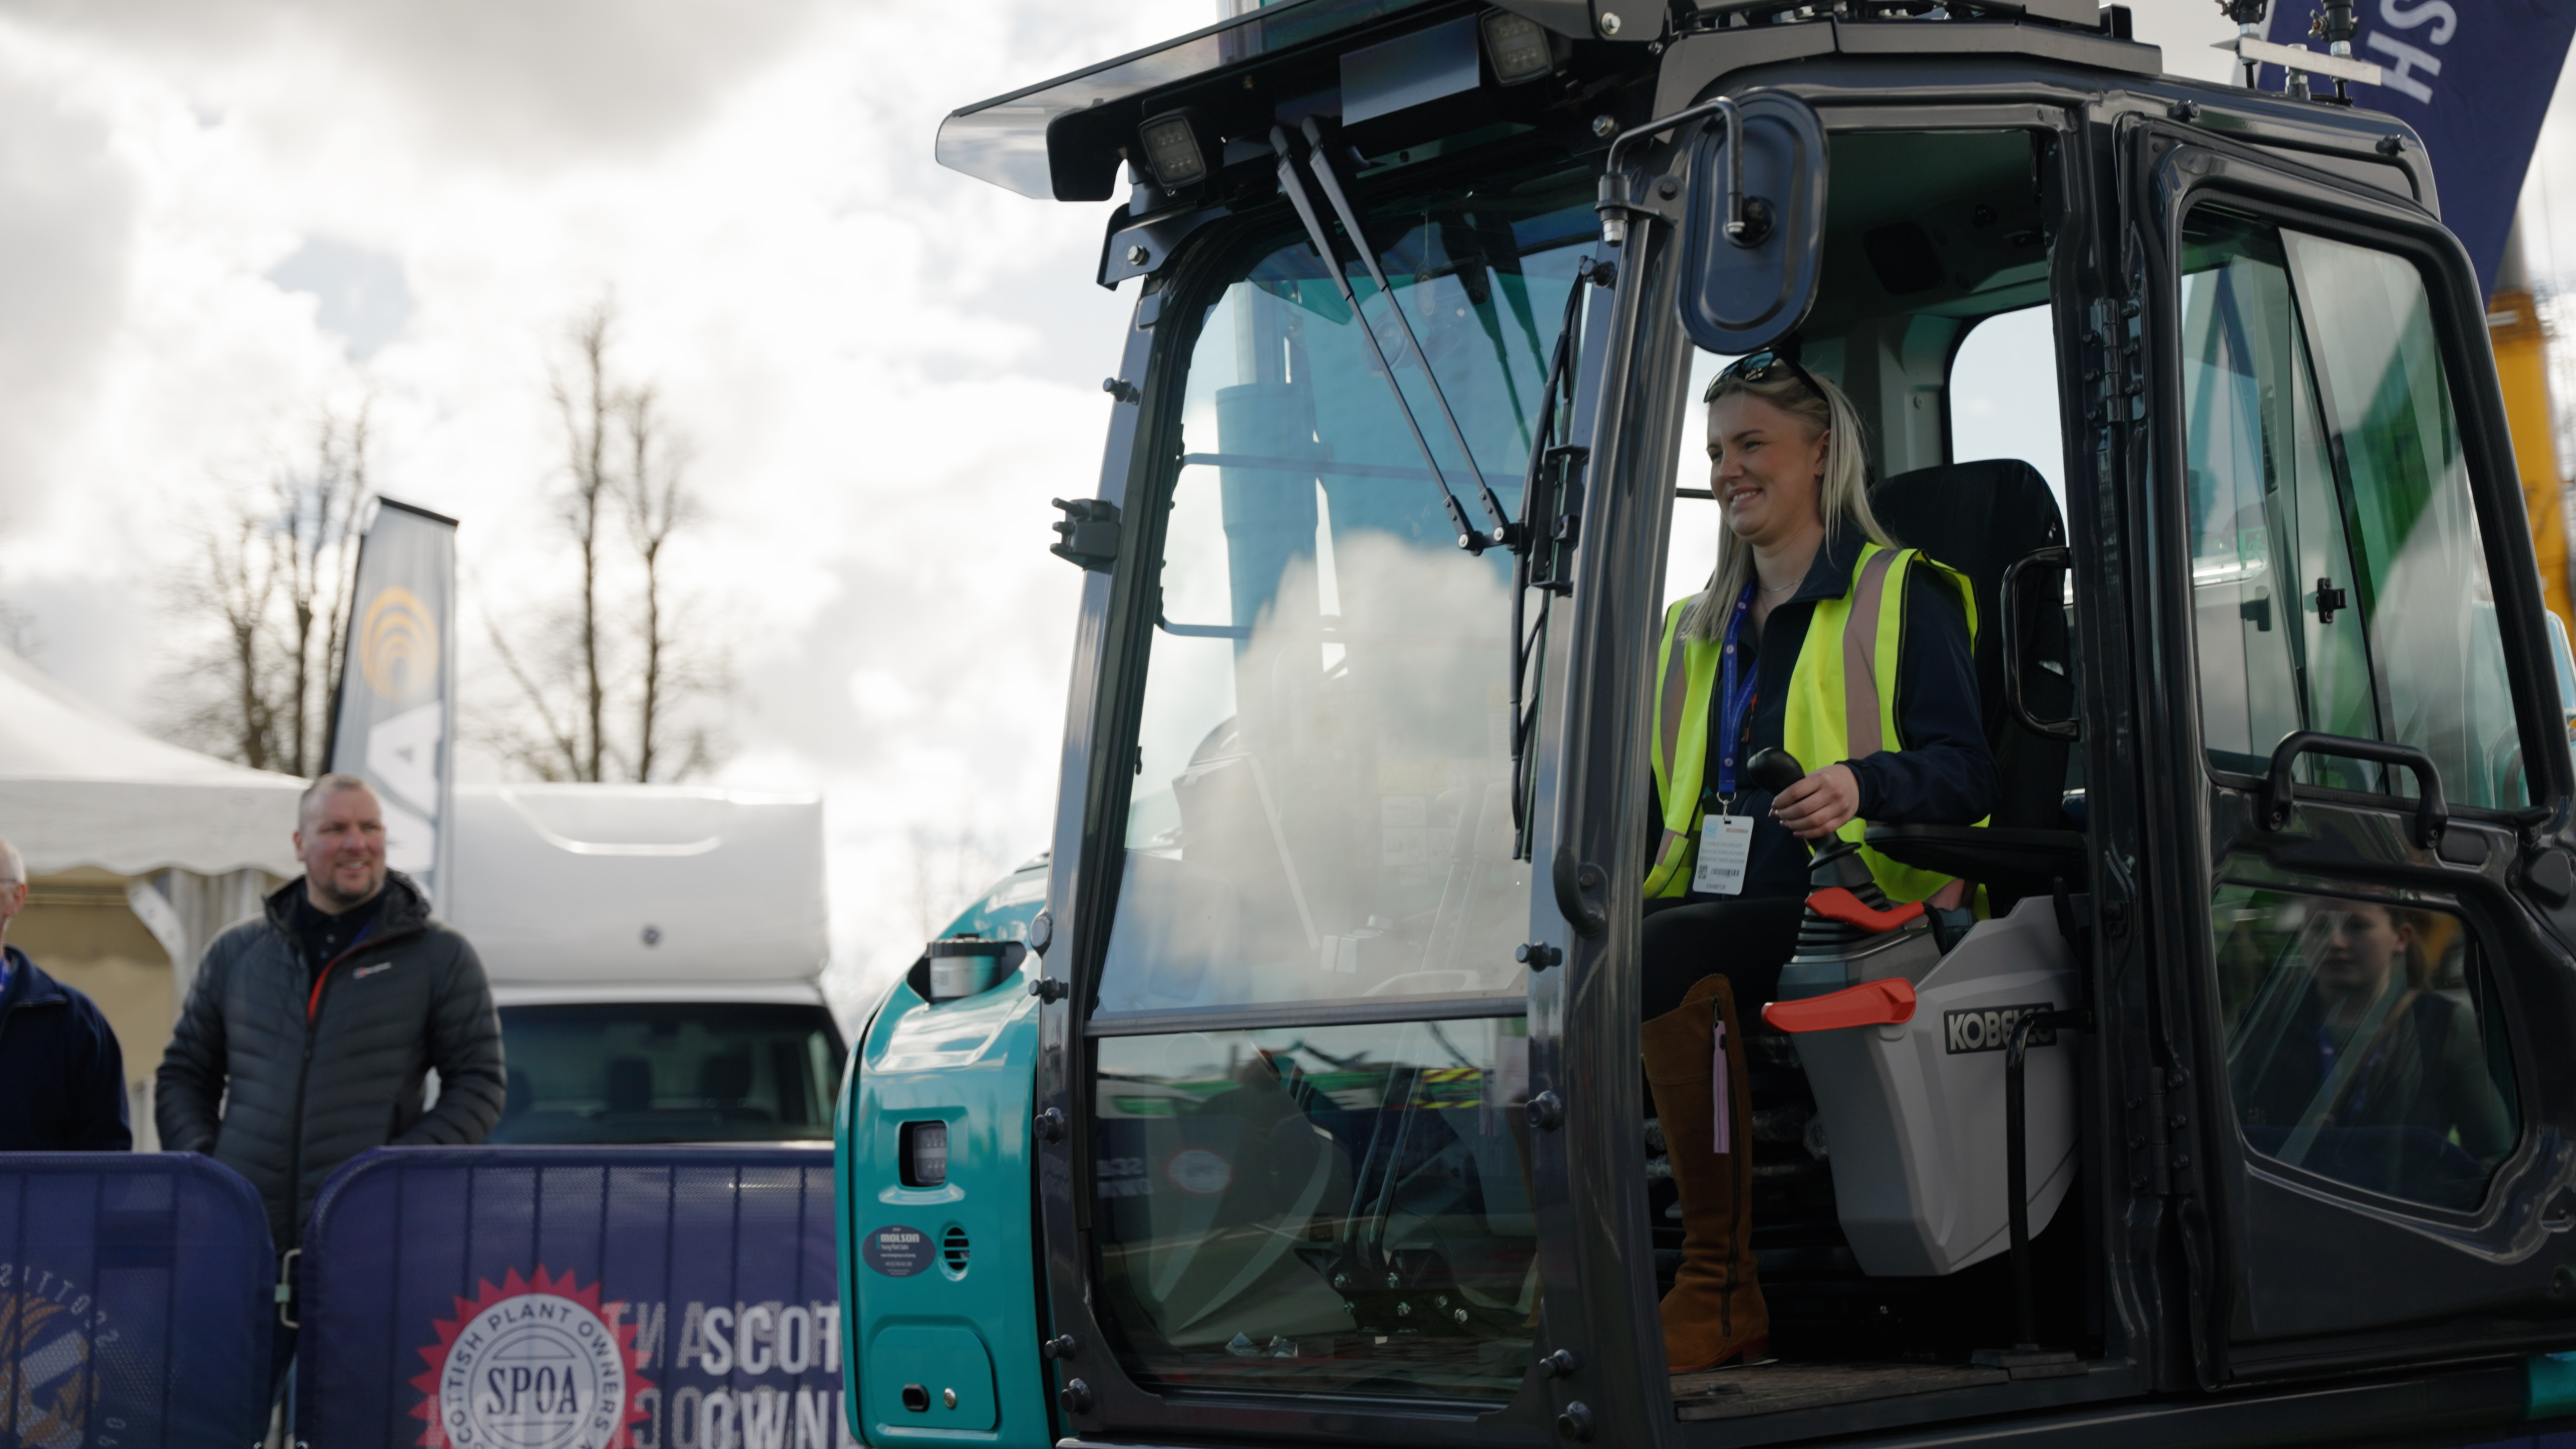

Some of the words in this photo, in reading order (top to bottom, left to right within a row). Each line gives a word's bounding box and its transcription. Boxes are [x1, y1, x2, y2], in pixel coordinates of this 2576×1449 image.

[486, 1365, 578, 1416] SPOA
[488, 1303, 572, 1332] PLANT
[578, 1321, 619, 1434] OWNERS
